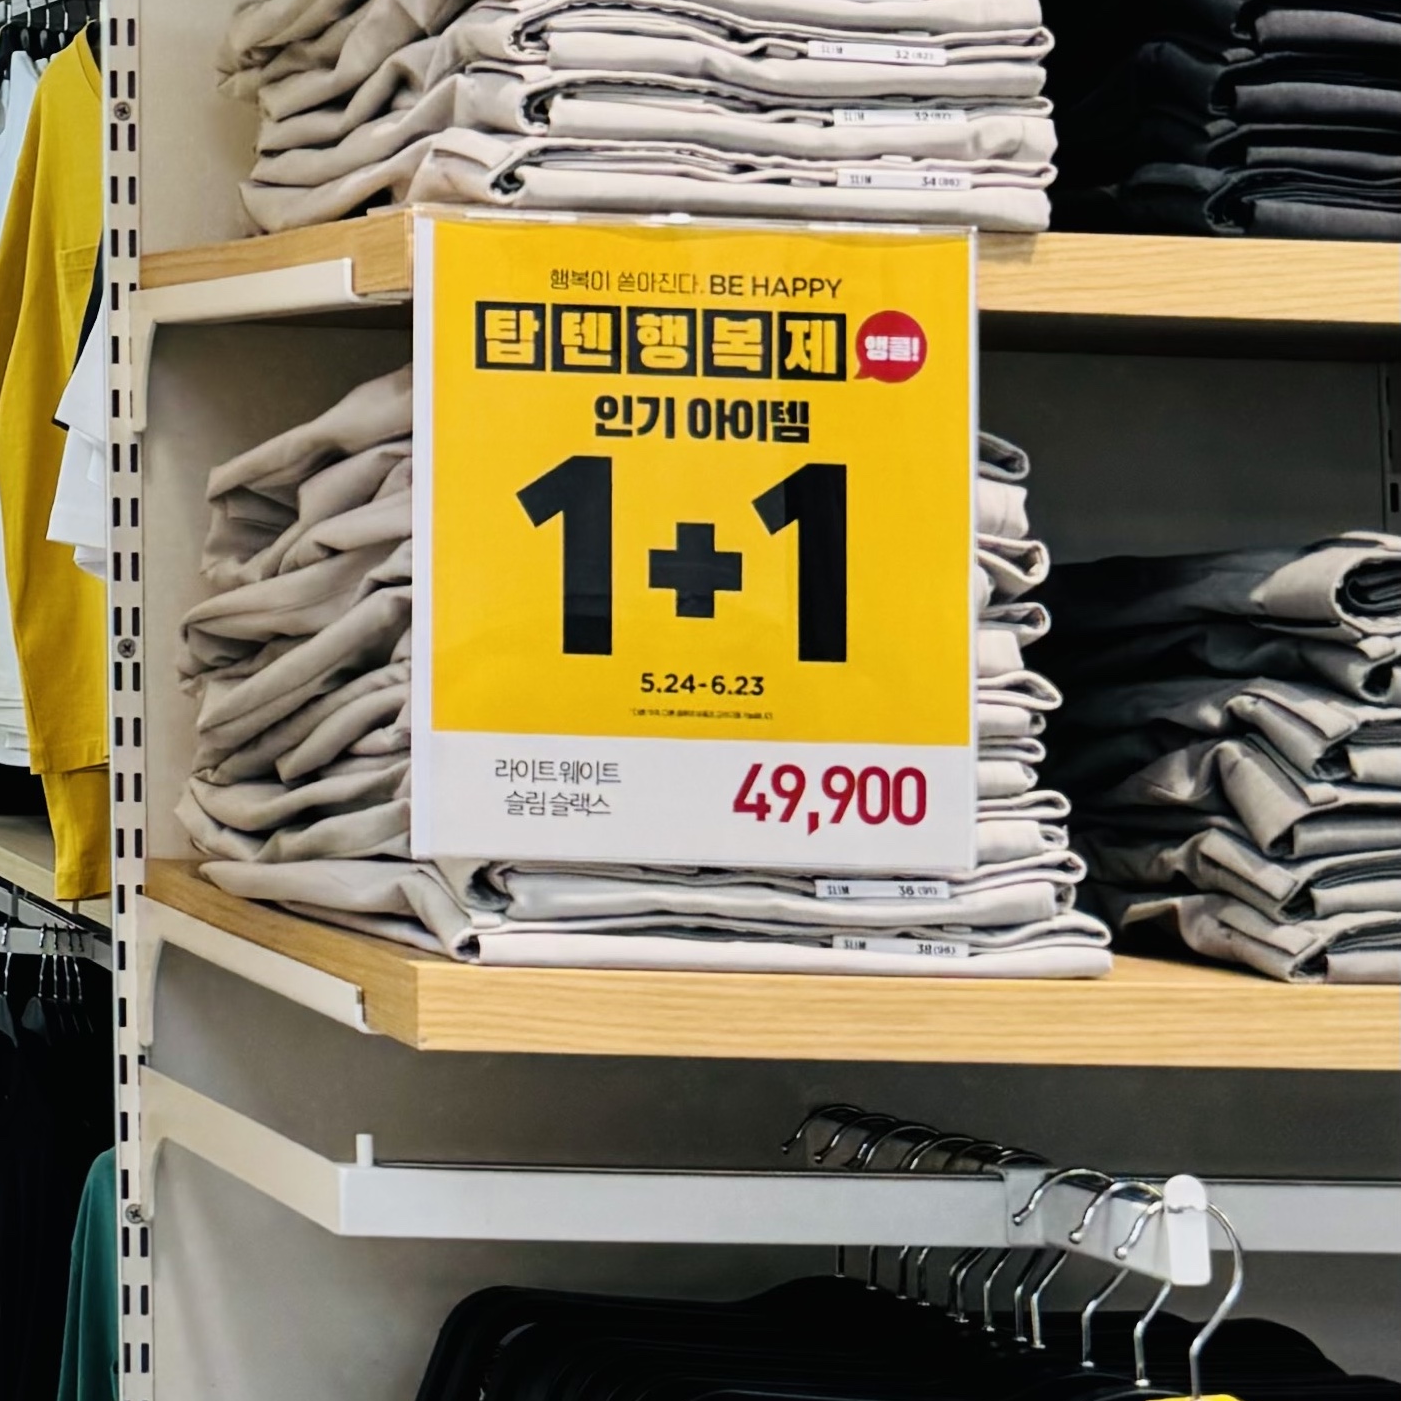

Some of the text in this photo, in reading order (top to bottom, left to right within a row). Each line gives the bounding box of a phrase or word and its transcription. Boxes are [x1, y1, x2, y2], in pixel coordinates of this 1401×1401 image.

[550, 268, 610, 292] 행복이
[709, 275, 744, 296] BE
[751, 276, 842, 299] HAPPY
[482, 308, 838, 376] 탑텐행복제
[594, 395, 811, 444] 인기 아이템
[515, 455, 848, 663] 1+1
[640, 672, 765, 696] 5.24-6.23
[504, 791, 612, 817] 슬림 슬랙스
[733, 763, 928, 836] 49,900
[827, 885, 851, 896] SLIM
[842, 939, 867, 950] SLIM
